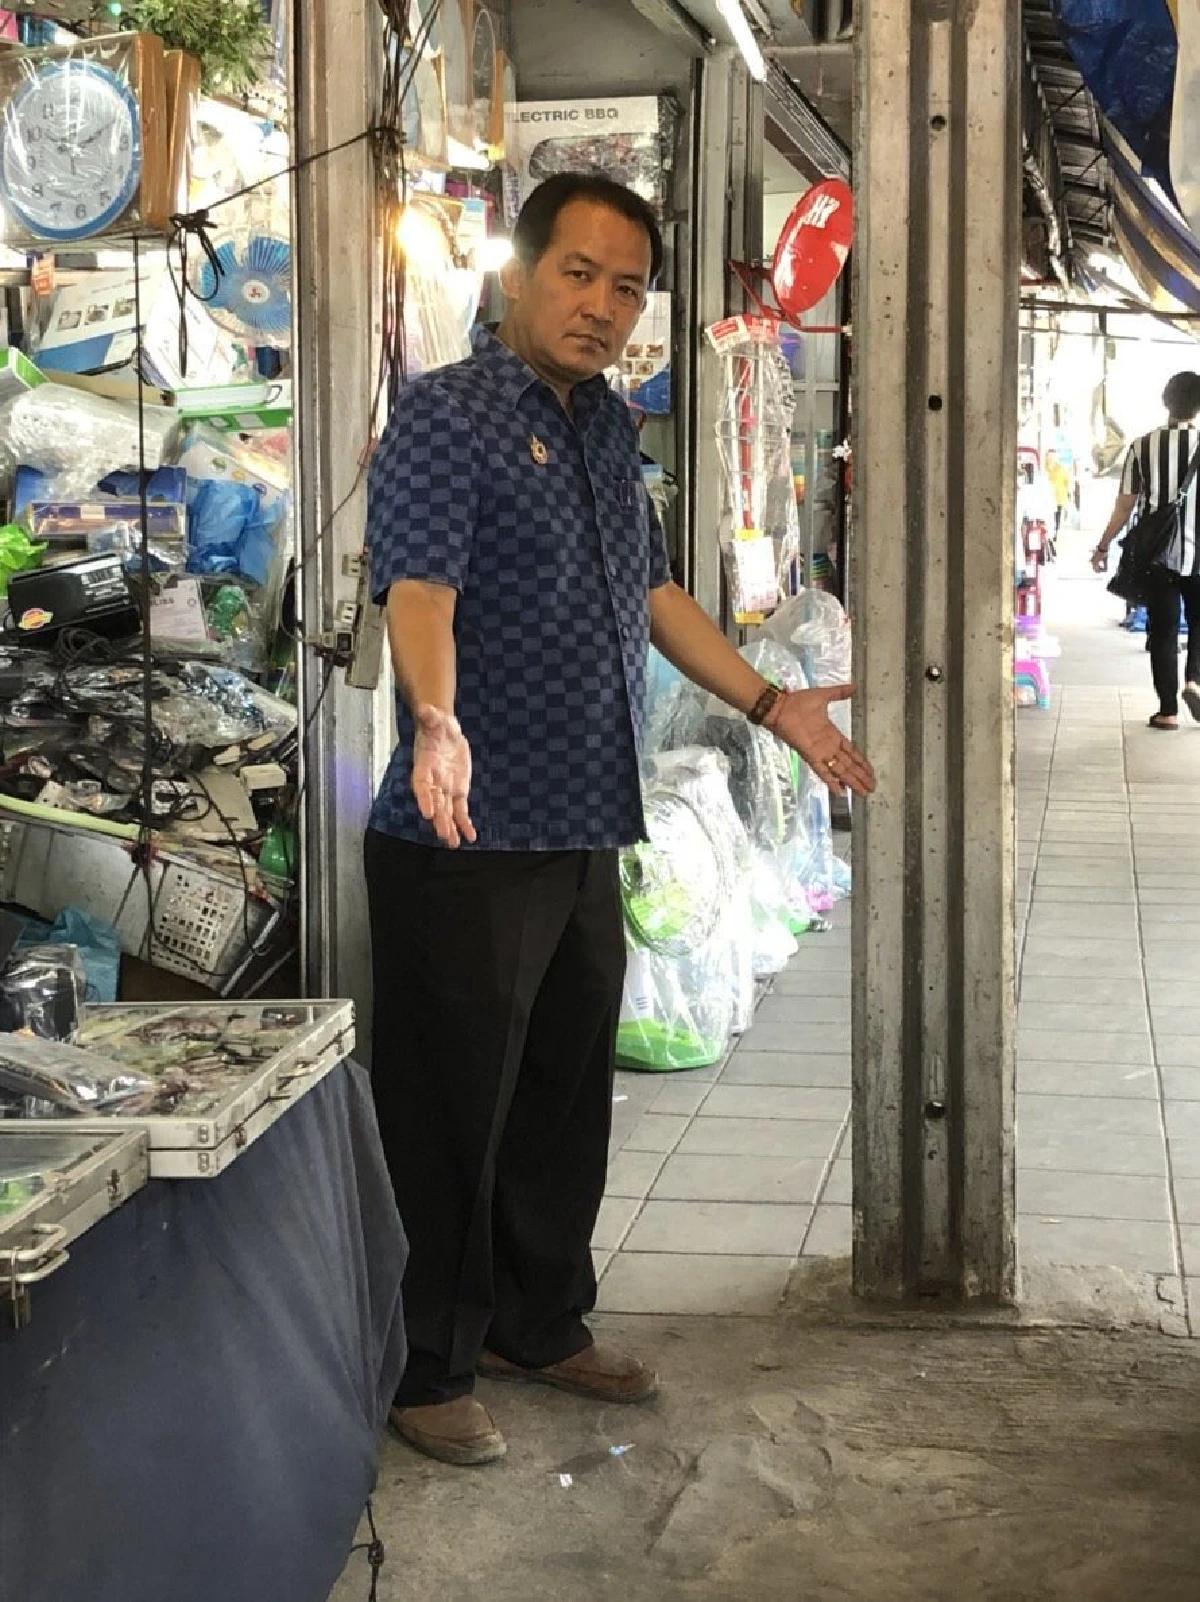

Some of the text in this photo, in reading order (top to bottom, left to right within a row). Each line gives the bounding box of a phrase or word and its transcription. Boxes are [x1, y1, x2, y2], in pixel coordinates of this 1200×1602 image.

[504, 108, 619, 124] LECTRIC BBQ
[75, 203, 86, 219] 6
